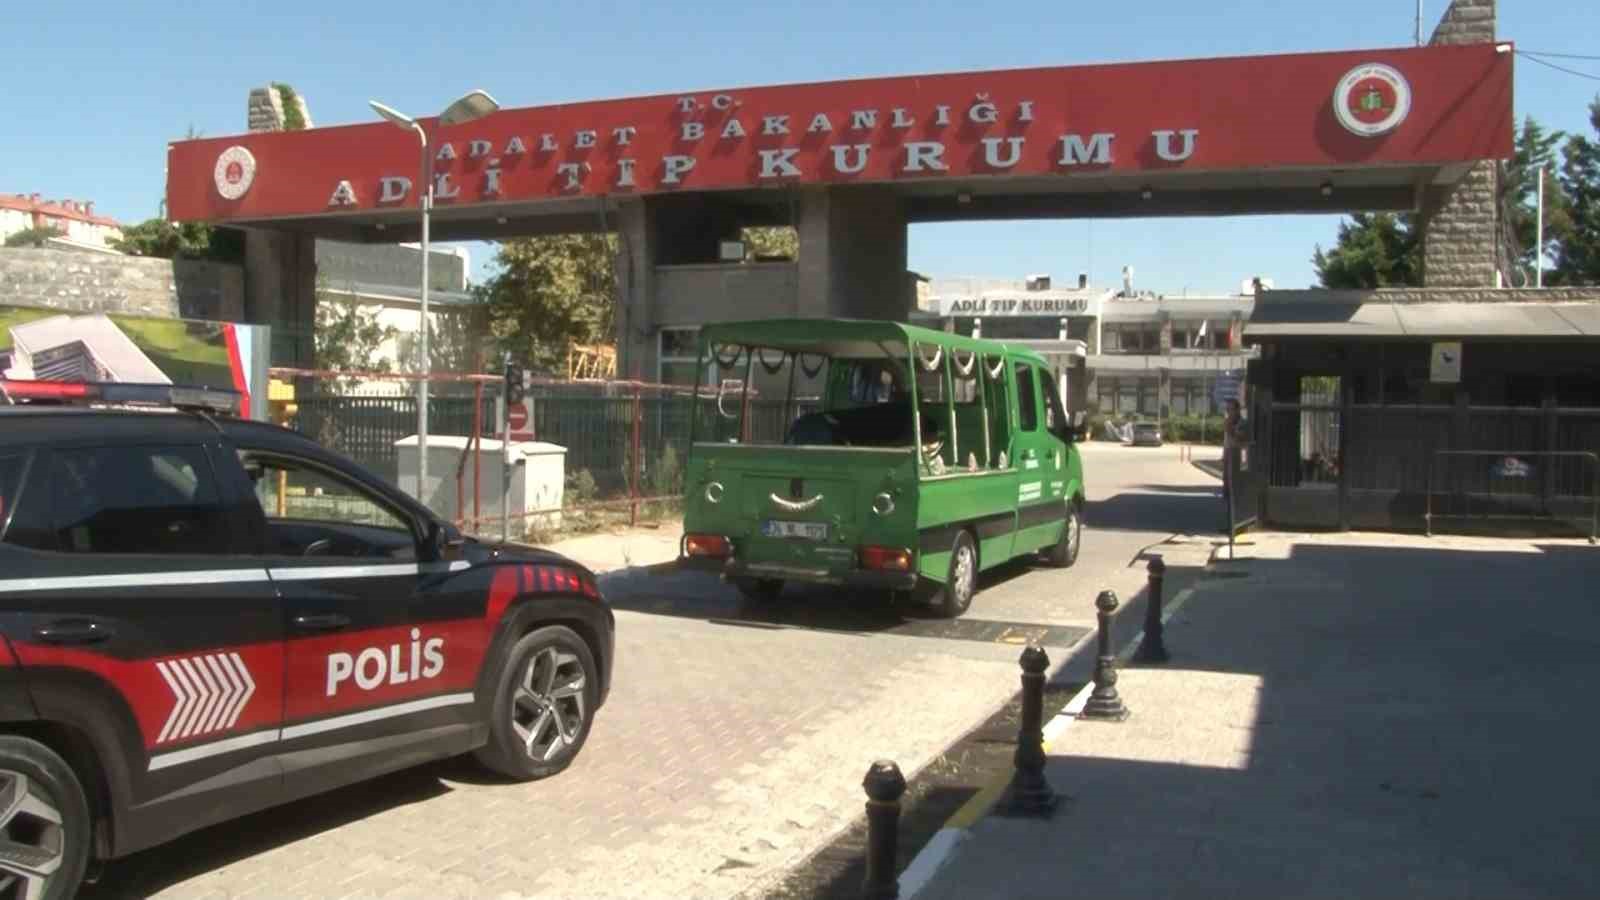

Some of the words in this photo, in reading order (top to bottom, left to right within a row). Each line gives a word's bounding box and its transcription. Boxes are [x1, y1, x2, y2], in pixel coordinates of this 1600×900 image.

[436, 126, 637, 160] ADALET
[680, 91, 1036, 140] BAKANLIĞI
[677, 94, 743, 112] T.C.
[328, 158, 502, 207] ADLİ
[557, 154, 697, 190] TIP
[758, 128, 1199, 178] KURUMU
[951, 299, 986, 312] ADLİ
[992, 299, 1017, 312] TIP
[1020, 299, 1088, 313] KURUMU
[325, 626, 445, 697] POLİS
